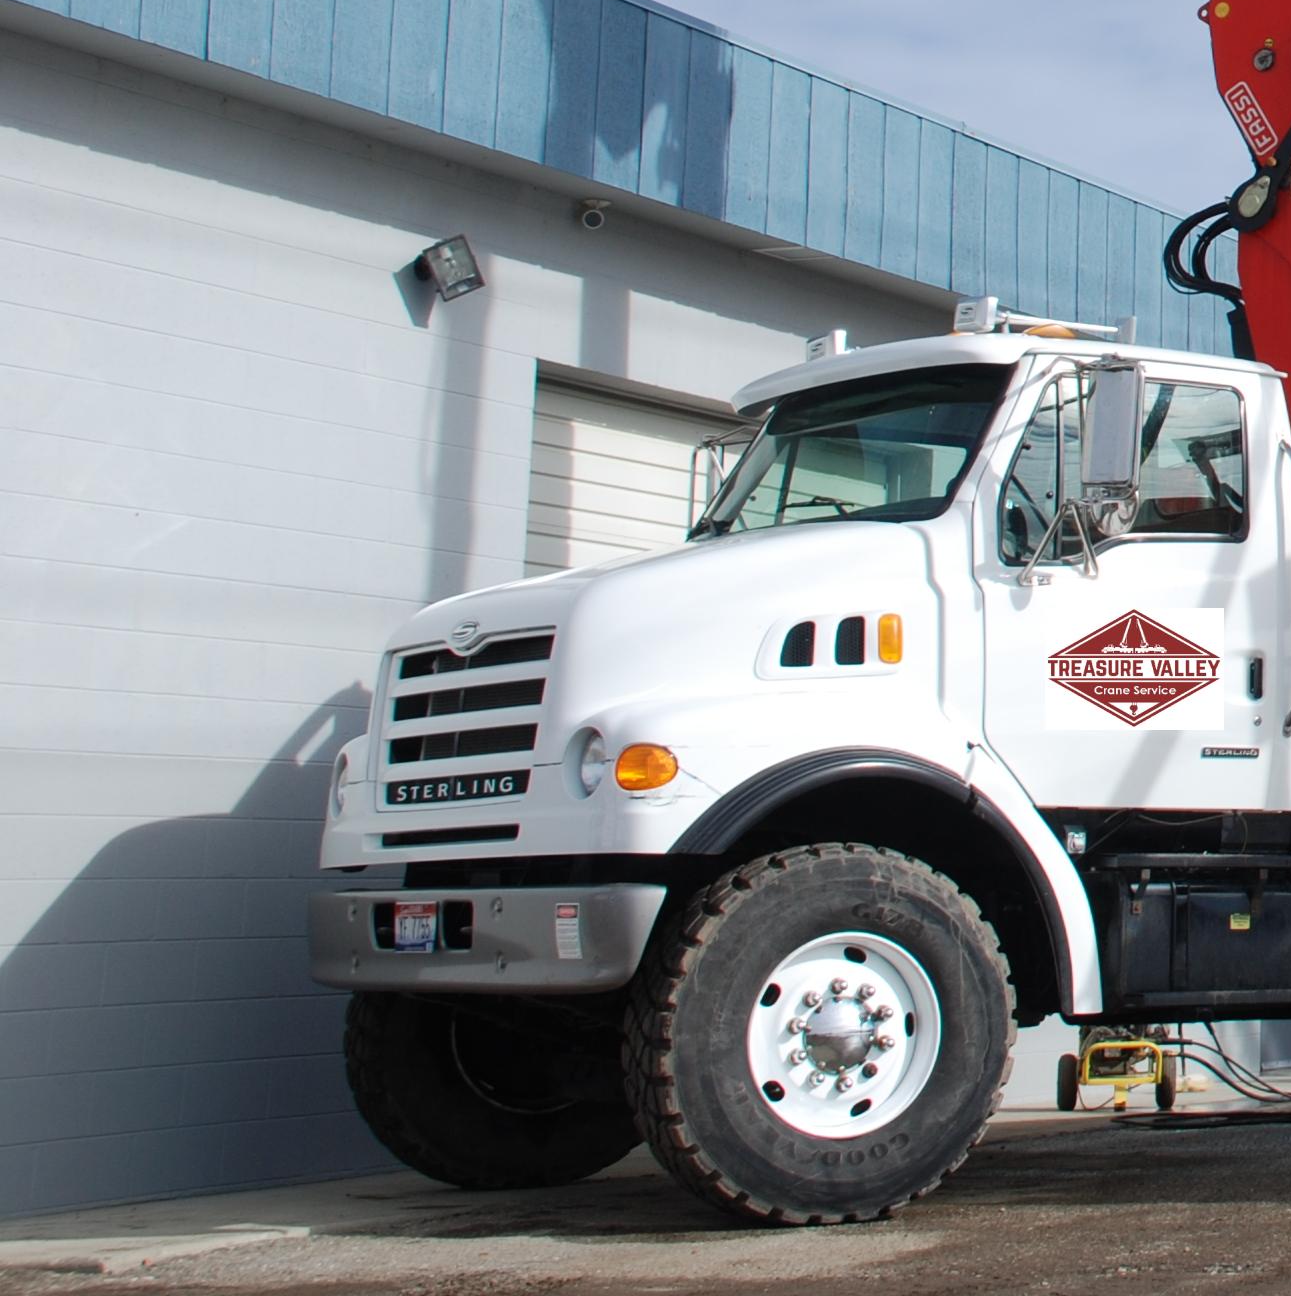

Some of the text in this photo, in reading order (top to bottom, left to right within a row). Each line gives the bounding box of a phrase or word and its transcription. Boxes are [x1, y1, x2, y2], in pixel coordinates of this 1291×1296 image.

[1231, 88, 1272, 148] FASSI
[1048, 659, 1221, 677] TREASURE VALLEY
[1094, 685, 1177, 695] Crane Service
[1204, 748, 1258, 756] STERLING
[395, 776, 515, 802] STERLING
